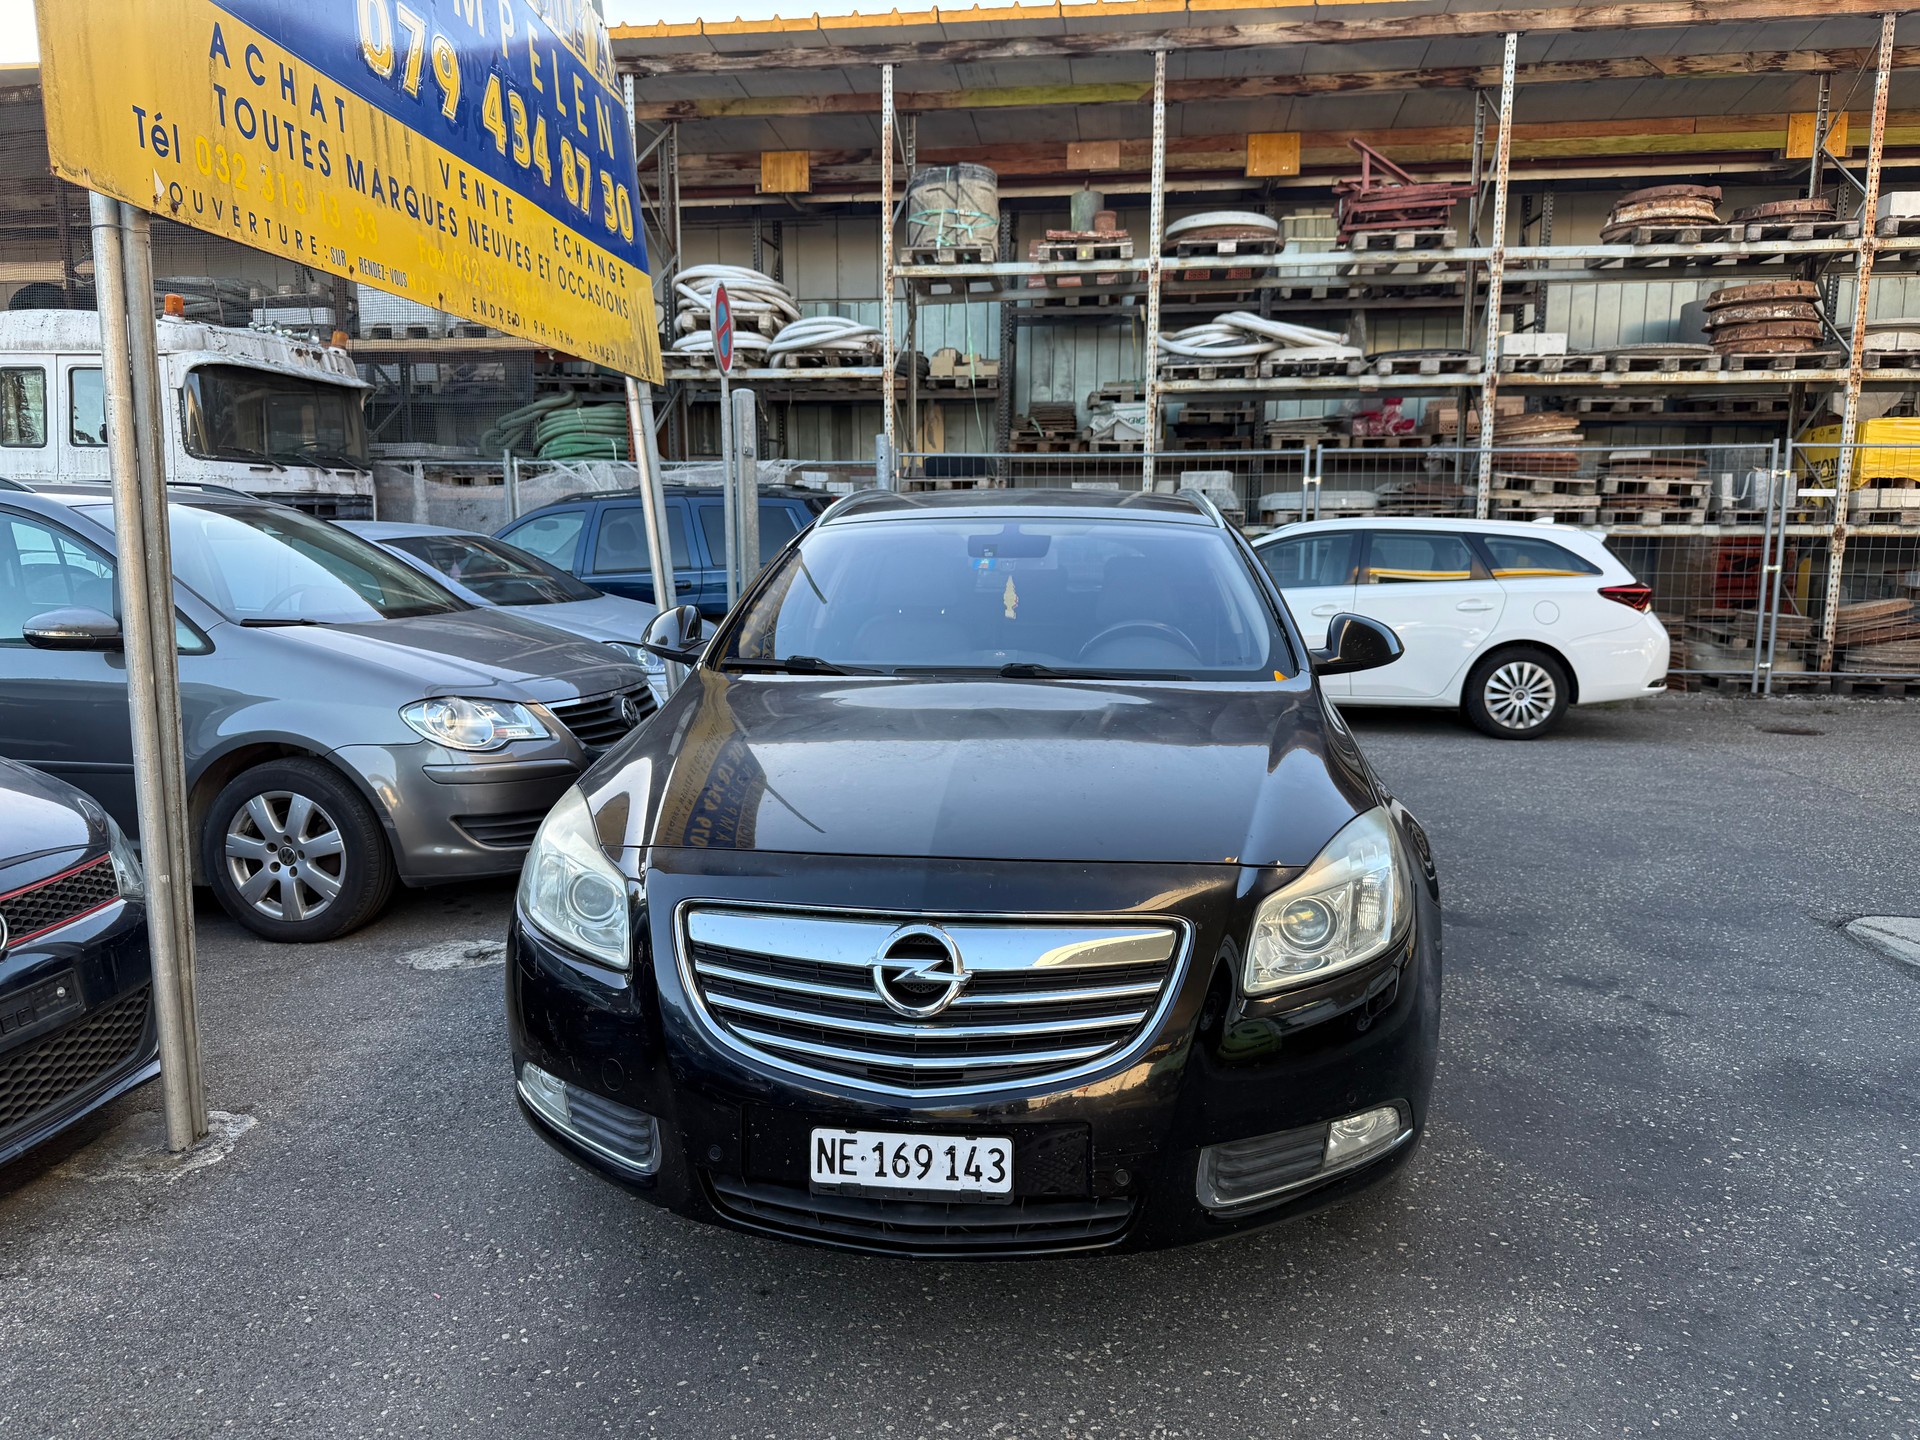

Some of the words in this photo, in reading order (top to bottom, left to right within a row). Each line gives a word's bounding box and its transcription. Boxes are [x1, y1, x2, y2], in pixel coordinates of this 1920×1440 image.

[132, 104, 181, 164] Tél
[195, 135, 248, 192] 032
[261, 164, 306, 215] 313
[318, 190, 342, 228] 13
[354, 206, 378, 245] 33
[453, 251, 481, 287] 032
[210, 21, 345, 133] ACHAT
[438, 158, 514, 224] VENTE
[553, 227, 625, 288] ECHANGE
[213, 83, 331, 177] TOUTES
[345, 153, 458, 237] MARQUES
[467, 216, 531, 272] NEUVES
[538, 253, 551, 282] ET
[558, 265, 628, 320] OCCASIONS
[357, 0, 463, 121] 079
[482, 72, 552, 187] 434
[560, 135, 592, 216] 87
[599, 170, 634, 243] 30
[330, 247, 347, 267] SUR
[358, 256, 408, 288] RENDEZ-VOUS
[943, 1145, 1006, 1184] 143
